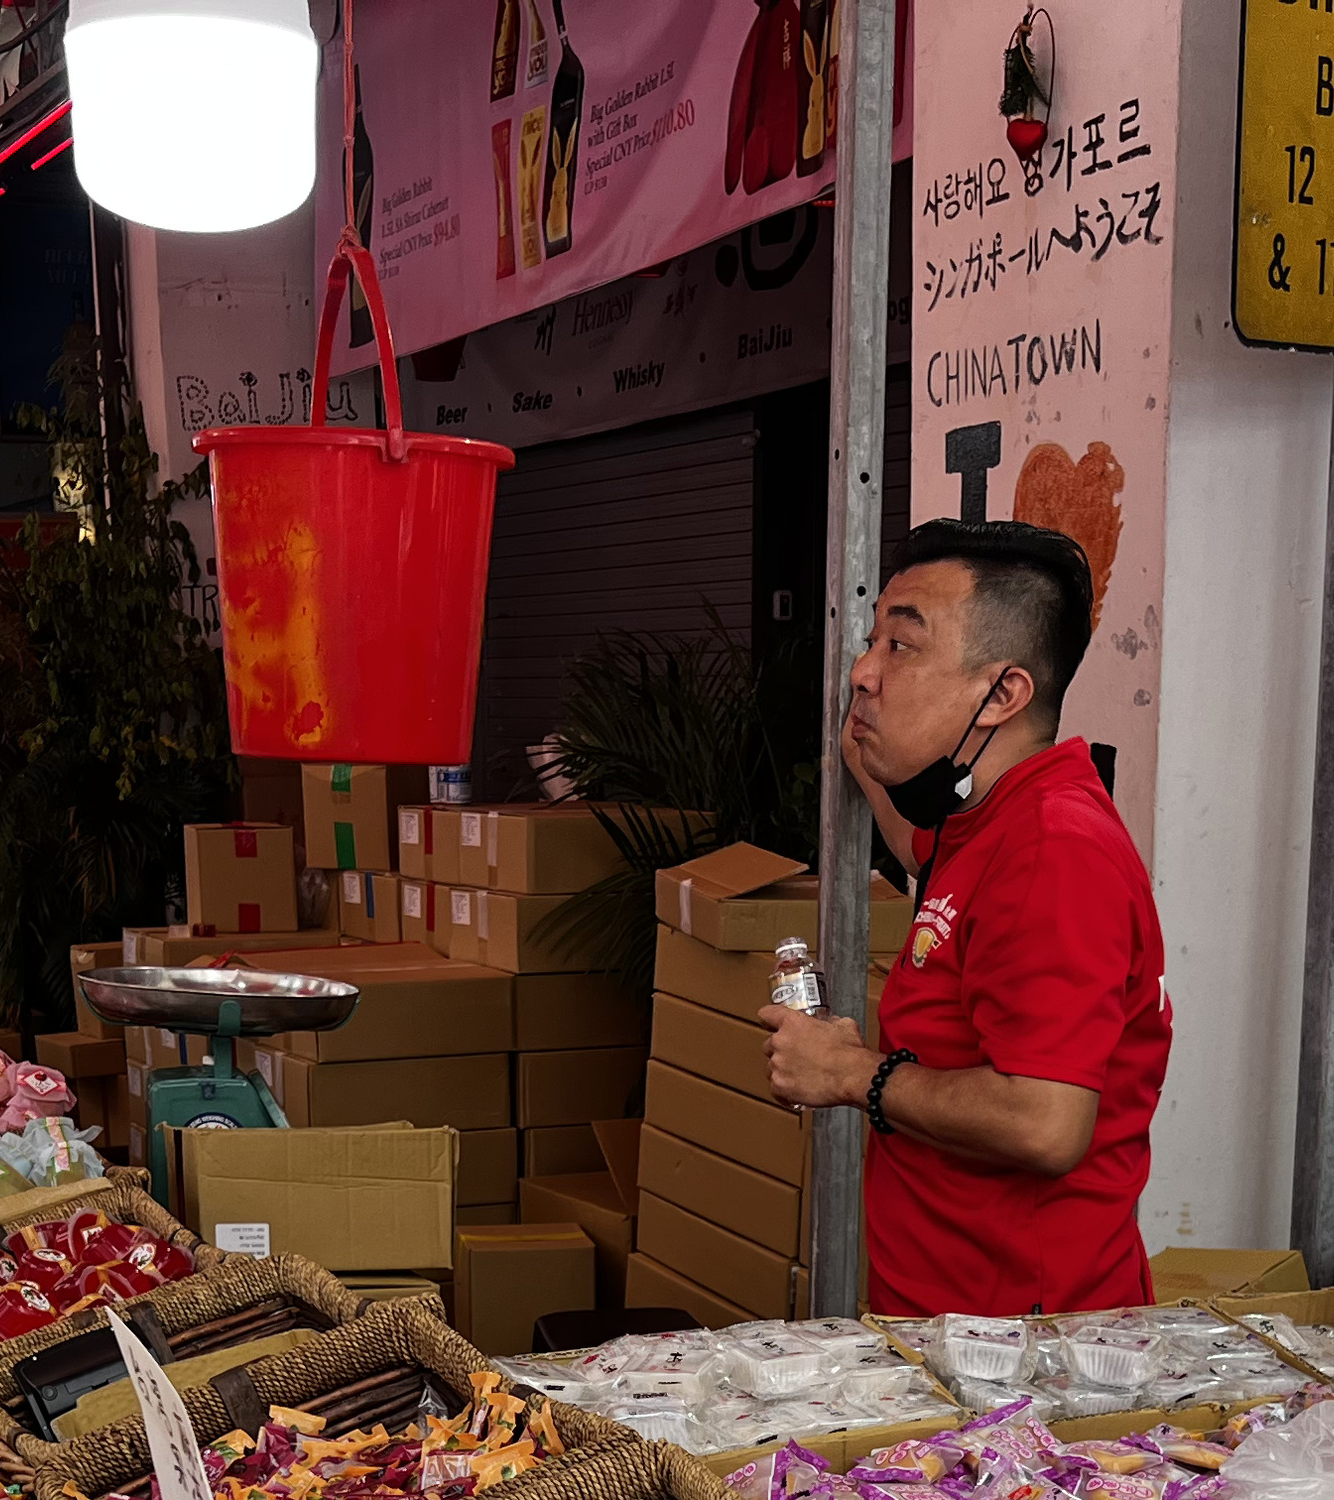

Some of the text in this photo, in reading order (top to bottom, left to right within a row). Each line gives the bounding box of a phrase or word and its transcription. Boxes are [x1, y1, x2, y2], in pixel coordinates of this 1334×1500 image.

[590, 103, 605, 125] Big
[606, 88, 633, 115] Golden
[634, 73, 660, 99] Rabbit
[586, 153, 613, 179] Special
[614, 138, 634, 163] CNY
[633, 130, 652, 153] Price
[587, 114, 638, 148] with Gift Box
[923, 158, 1007, 227] 사랑해요
[1284, 145, 1315, 206] 12
[923, 181, 1163, 311] シンガポールへようこそ
[1268, 233, 1292, 294] &
[572, 286, 637, 337] Hennessy
[436, 325, 794, 428] Beer Sake Whisky BaiJiu
[926, 319, 1105, 408] CHINATOWN
